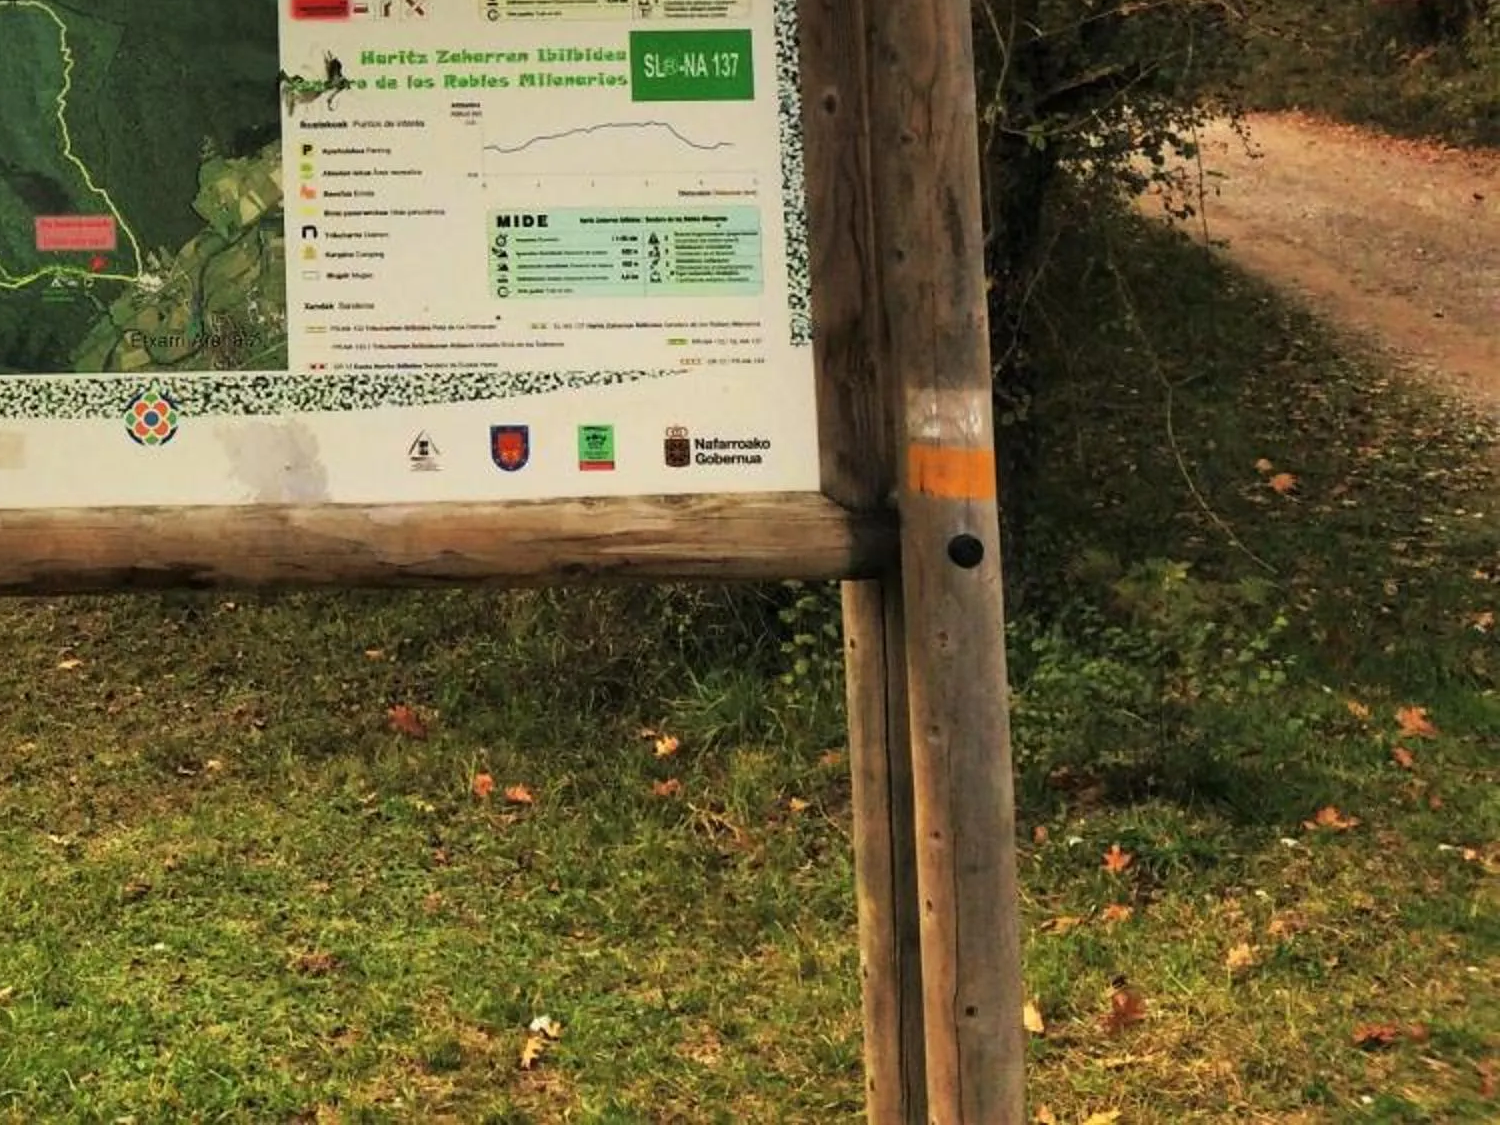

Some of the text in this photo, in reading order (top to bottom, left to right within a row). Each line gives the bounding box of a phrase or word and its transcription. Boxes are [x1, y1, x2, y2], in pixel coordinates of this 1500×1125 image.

[711, 51, 740, 78] 137
[302, 144, 313, 156] P
[496, 215, 549, 229] MIDE
[695, 437, 771, 452] Nafarroako
[695, 451, 763, 466] Gobernua
